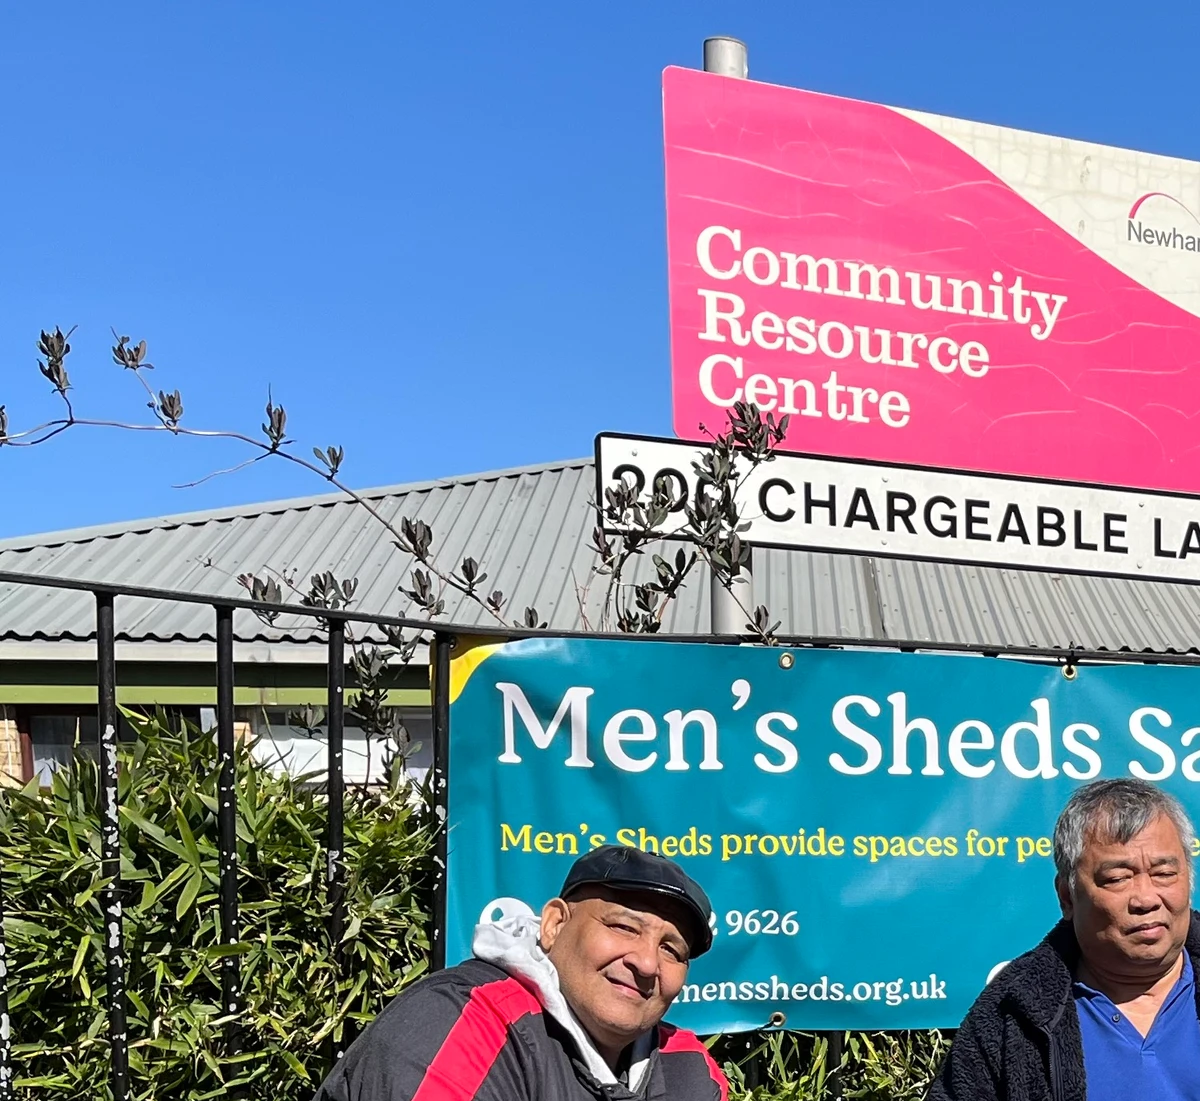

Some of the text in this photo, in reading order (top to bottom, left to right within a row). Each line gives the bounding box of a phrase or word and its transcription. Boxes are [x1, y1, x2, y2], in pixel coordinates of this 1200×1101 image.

[696, 225, 1068, 341] Community
[697, 288, 990, 378] Resource
[699, 353, 911, 428] Centre
[758, 477, 1129, 555] CHARGEABLE
[496, 679, 799, 773] Men’s
[828, 691, 1101, 780] Sheds
[616, 826, 712, 857] Sheds
[721, 828, 845, 862] provide
[853, 835, 958, 863] spaces
[966, 829, 1008, 856] for
[725, 909, 800, 936] 9626
